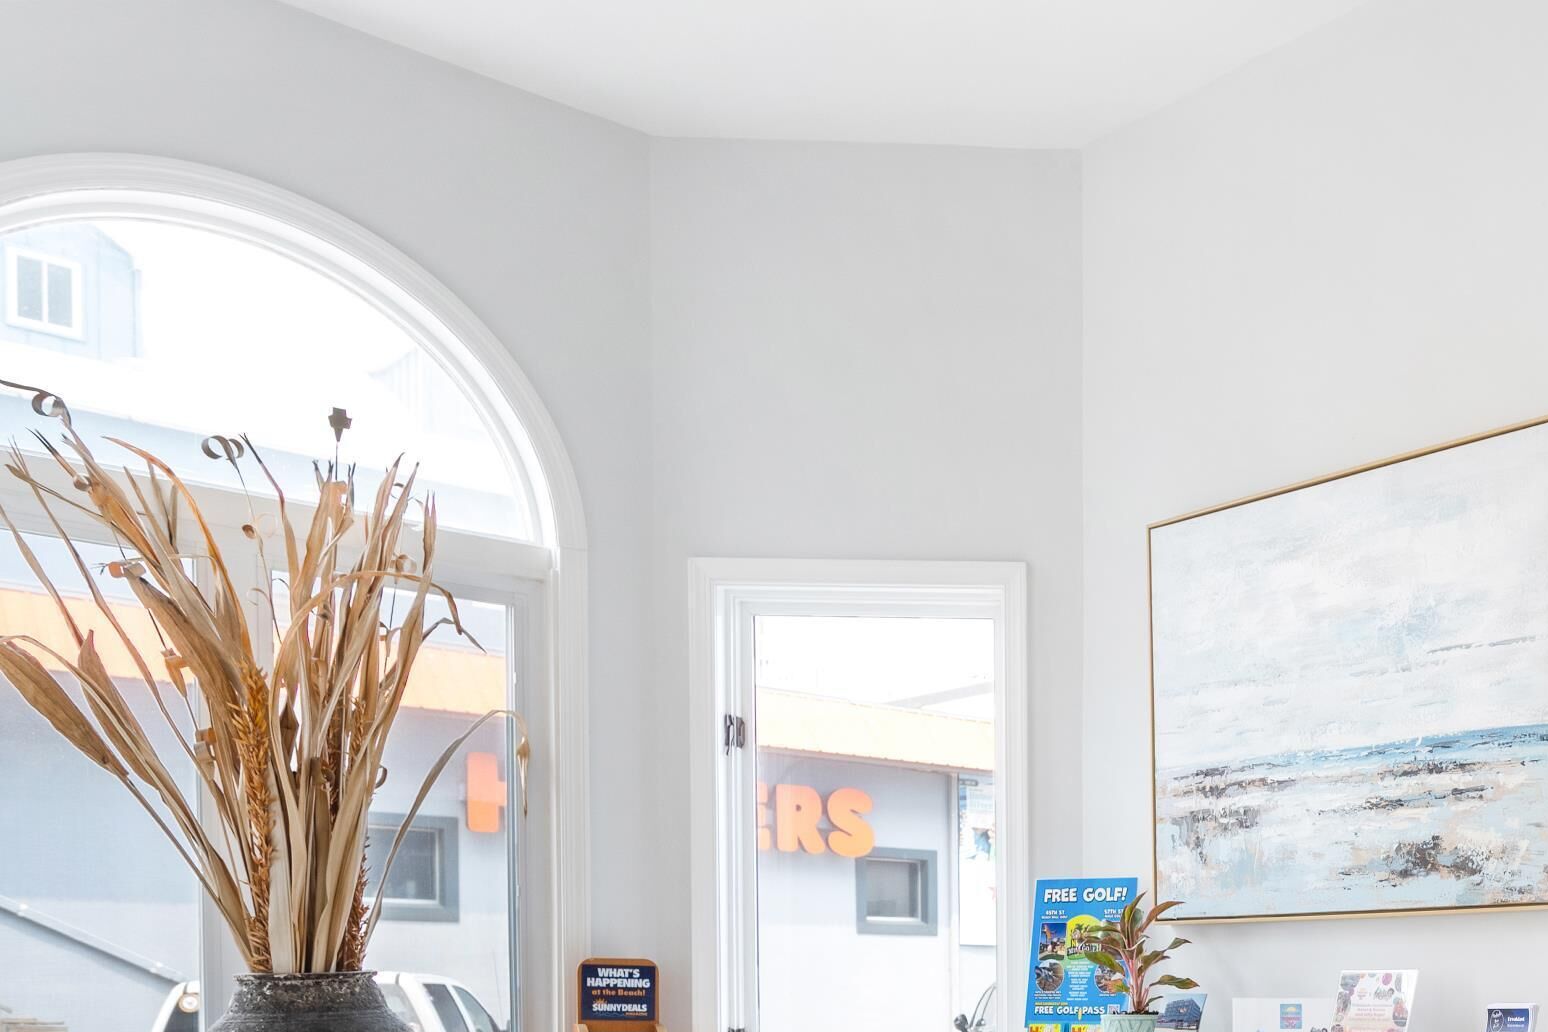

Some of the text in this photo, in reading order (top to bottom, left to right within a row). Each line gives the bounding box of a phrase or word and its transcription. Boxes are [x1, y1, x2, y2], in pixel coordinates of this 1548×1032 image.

[1044, 887, 1128, 902] FREE GOLF!
[597, 967, 640, 978] WHAT'S
[586, 977, 651, 989] HAPPENING
[617, 989, 646, 997] Beach!
[592, 1003, 648, 1012] SUNNYDEALS
[1034, 1006, 1054, 1014] FREE
[1082, 1006, 1105, 1015] PASS
